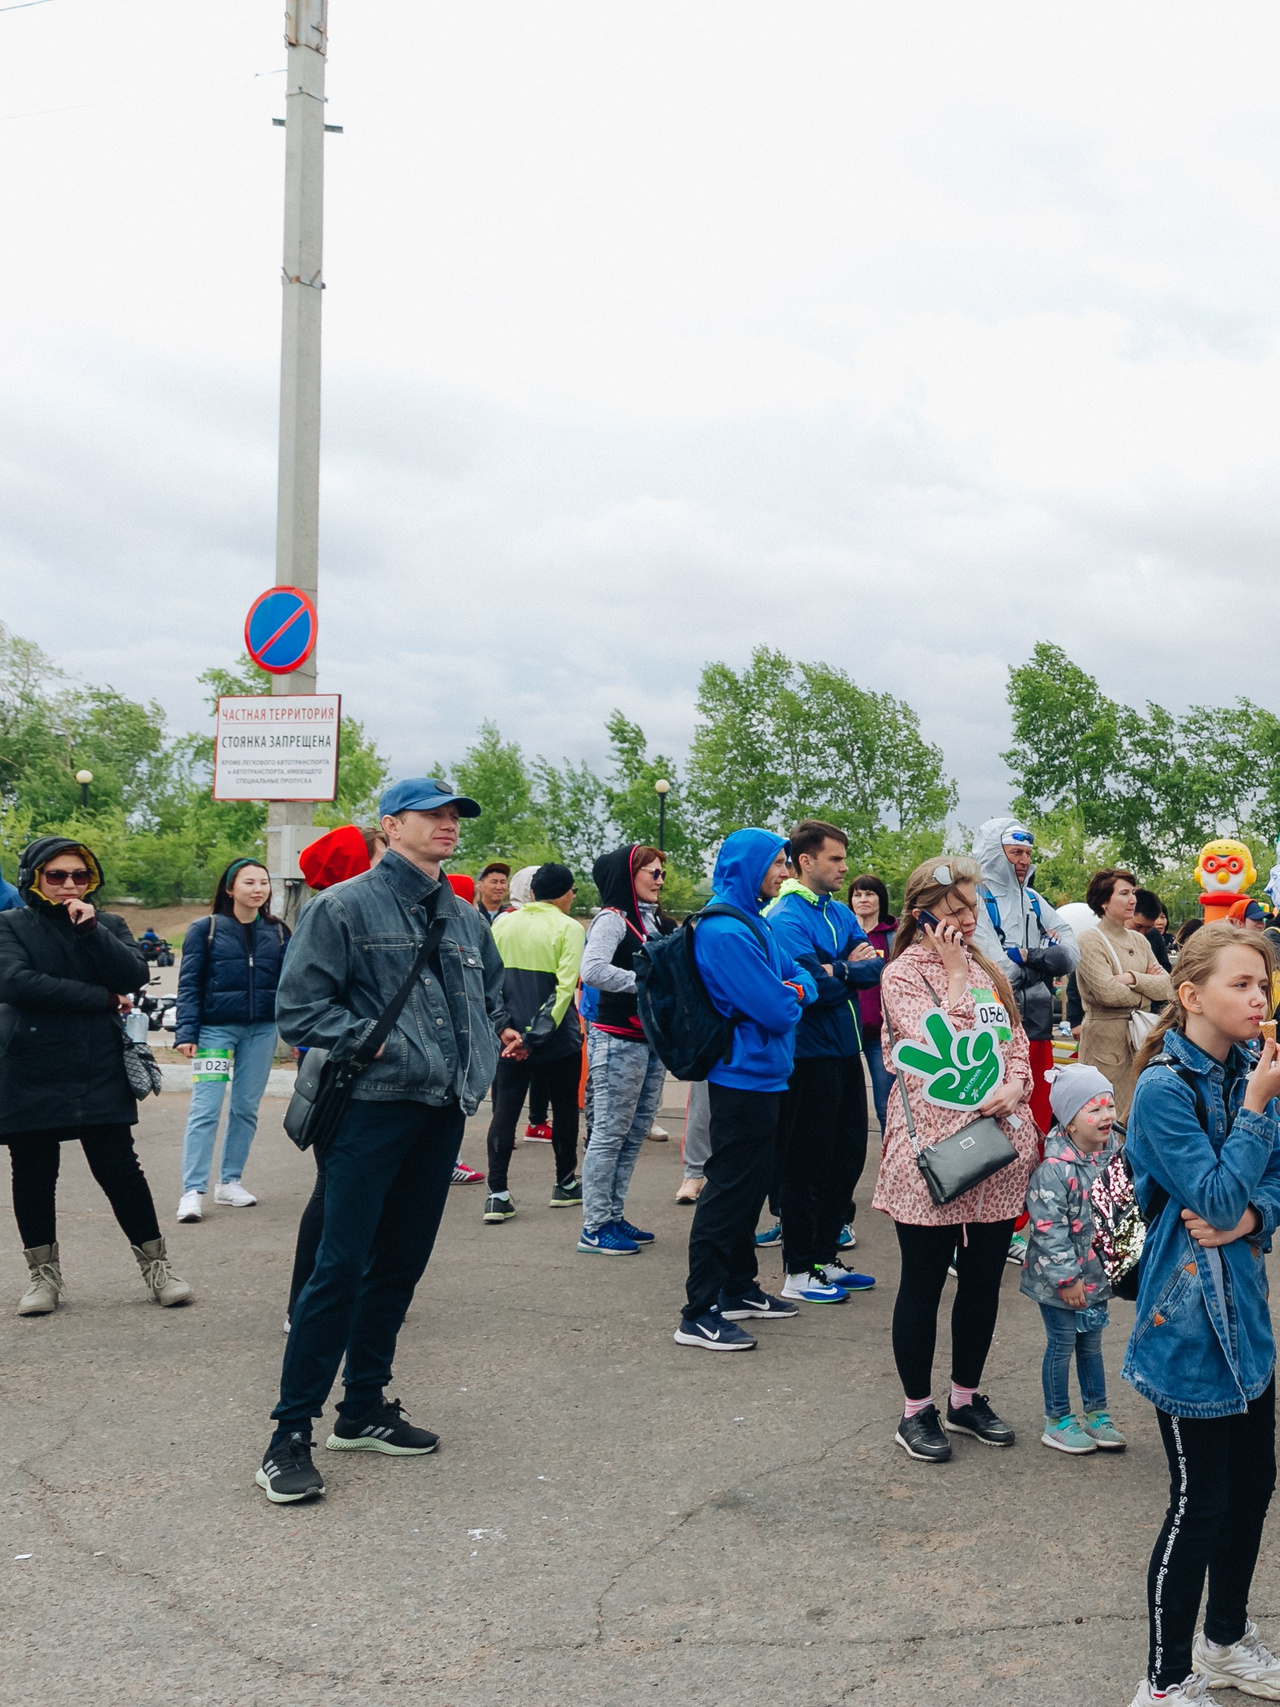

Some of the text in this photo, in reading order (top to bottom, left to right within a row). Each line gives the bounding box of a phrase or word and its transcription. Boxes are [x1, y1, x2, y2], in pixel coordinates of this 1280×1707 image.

[222, 707, 334, 721] ЧАСТНАЯ ТЕРРИТОРИЯ
[221, 734, 331, 749] СТОЯНКА ЗАПРЕЩЕНА
[1171, 1415, 1183, 1454] Superman
[1162, 1526, 1179, 1566] Superman
[1155, 1566, 1168, 1605] Superman
[1154, 1606, 1163, 1645] Superman
